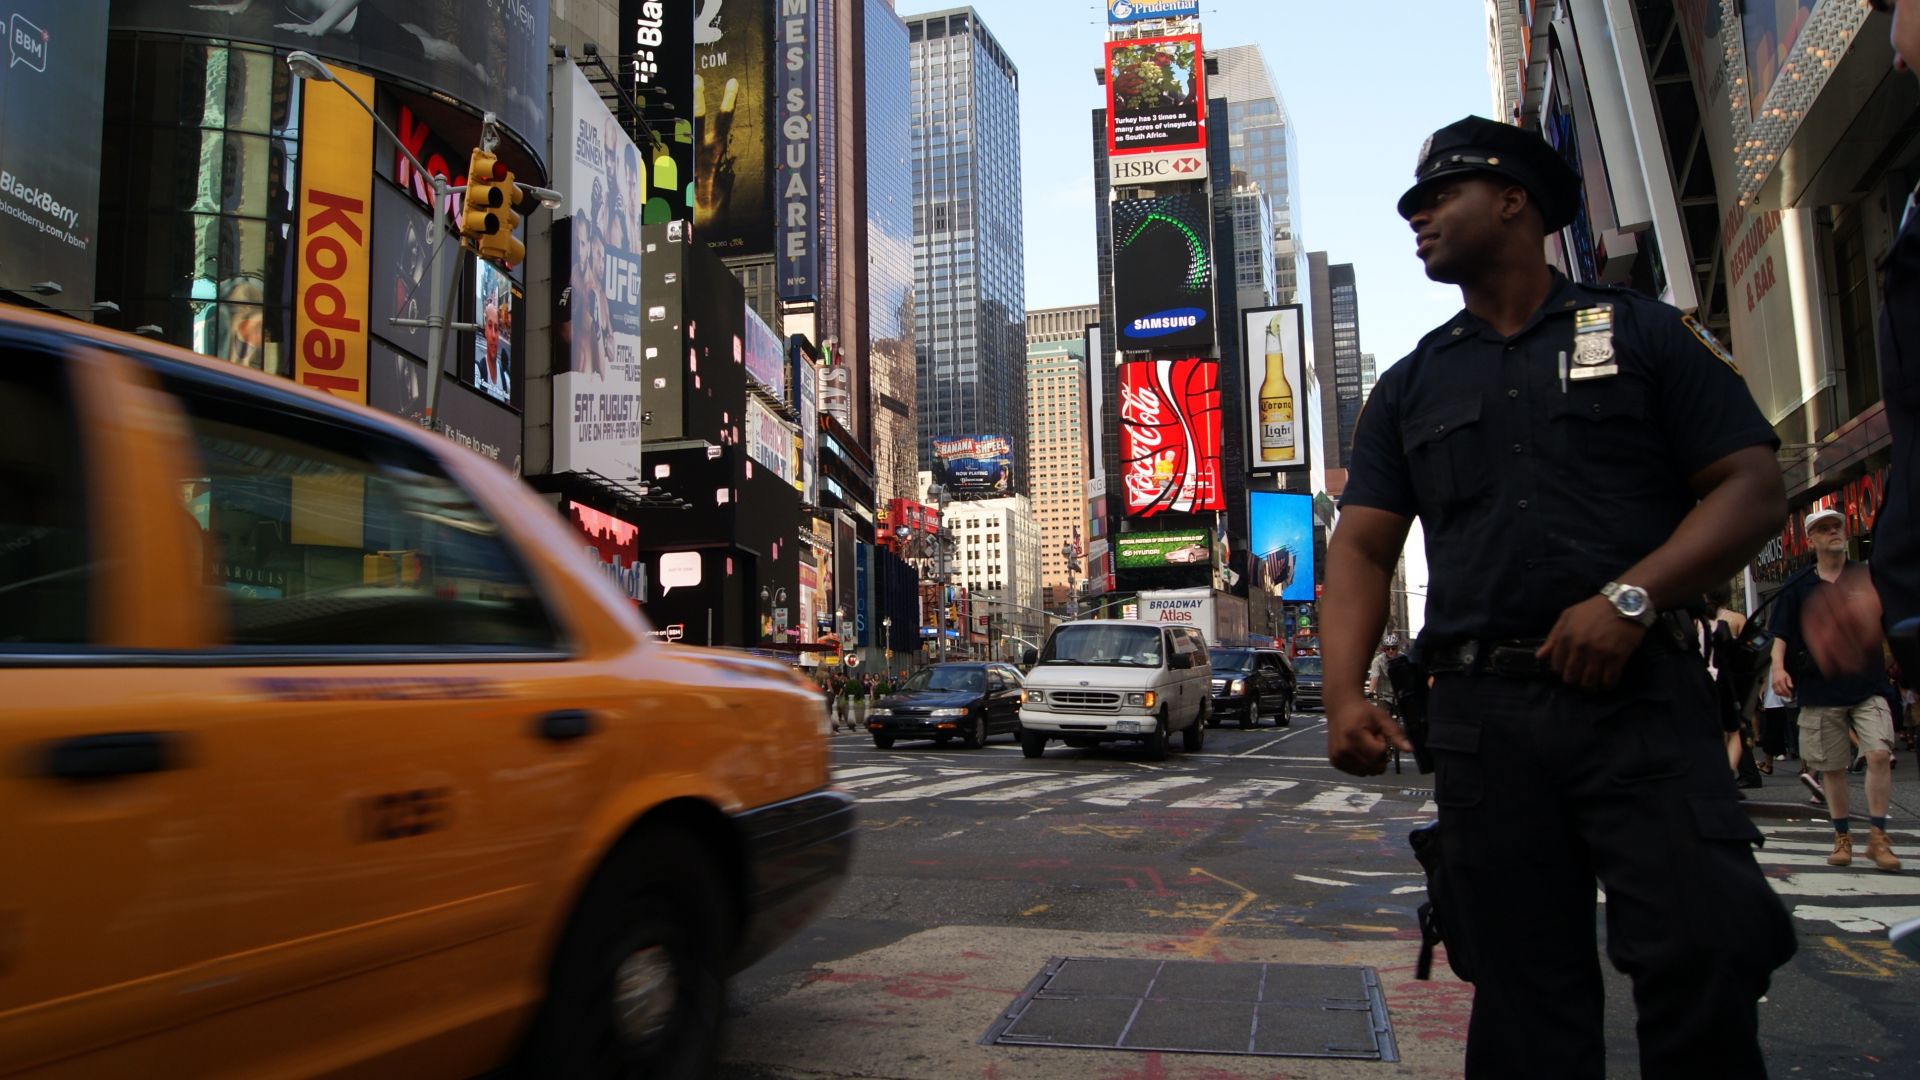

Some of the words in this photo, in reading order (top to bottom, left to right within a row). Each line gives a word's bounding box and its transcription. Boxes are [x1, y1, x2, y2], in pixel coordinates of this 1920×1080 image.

[1135, 0, 1196, 14] Prudential
[15, 29, 42, 58] BBM
[1163, 120, 1197, 129] vineyards
[1125, 133, 1145, 141] South
[1146, 131, 1169, 139] Africa.
[783, 88, 810, 257] SQUARE
[1113, 159, 1170, 179] HSBC
[0, 170, 79, 229] BlackBerry
[605, 254, 638, 306] UFC
[787, 277, 806, 286] NYC
[1746, 282, 1756, 313] &
[1754, 255, 1777, 303] BAR
[1134, 315, 1196, 330] SAMSUNG
[574, 393, 597, 423] SAT.
[599, 394, 634, 421] AUGUST
[635, 395, 641, 417] 7
[1261, 401, 1292, 413] Corona
[579, 423, 592, 442] LIVE
[594, 423, 602, 440] ON
[603, 422, 640, 440] PAY-PER-VIEW
[1264, 424, 1291, 439] Light
[456, 429, 472, 448] time
[473, 436, 480, 452] to
[942, 441, 973, 454] BANANA
[975, 439, 1005, 454] SHPEEL
[1133, 548, 1160, 556] HYUNDAI
[210, 562, 284, 585] MARQUIS
[1150, 600, 1203, 610] BROADWAY
[1159, 610, 1192, 622] Atlas
